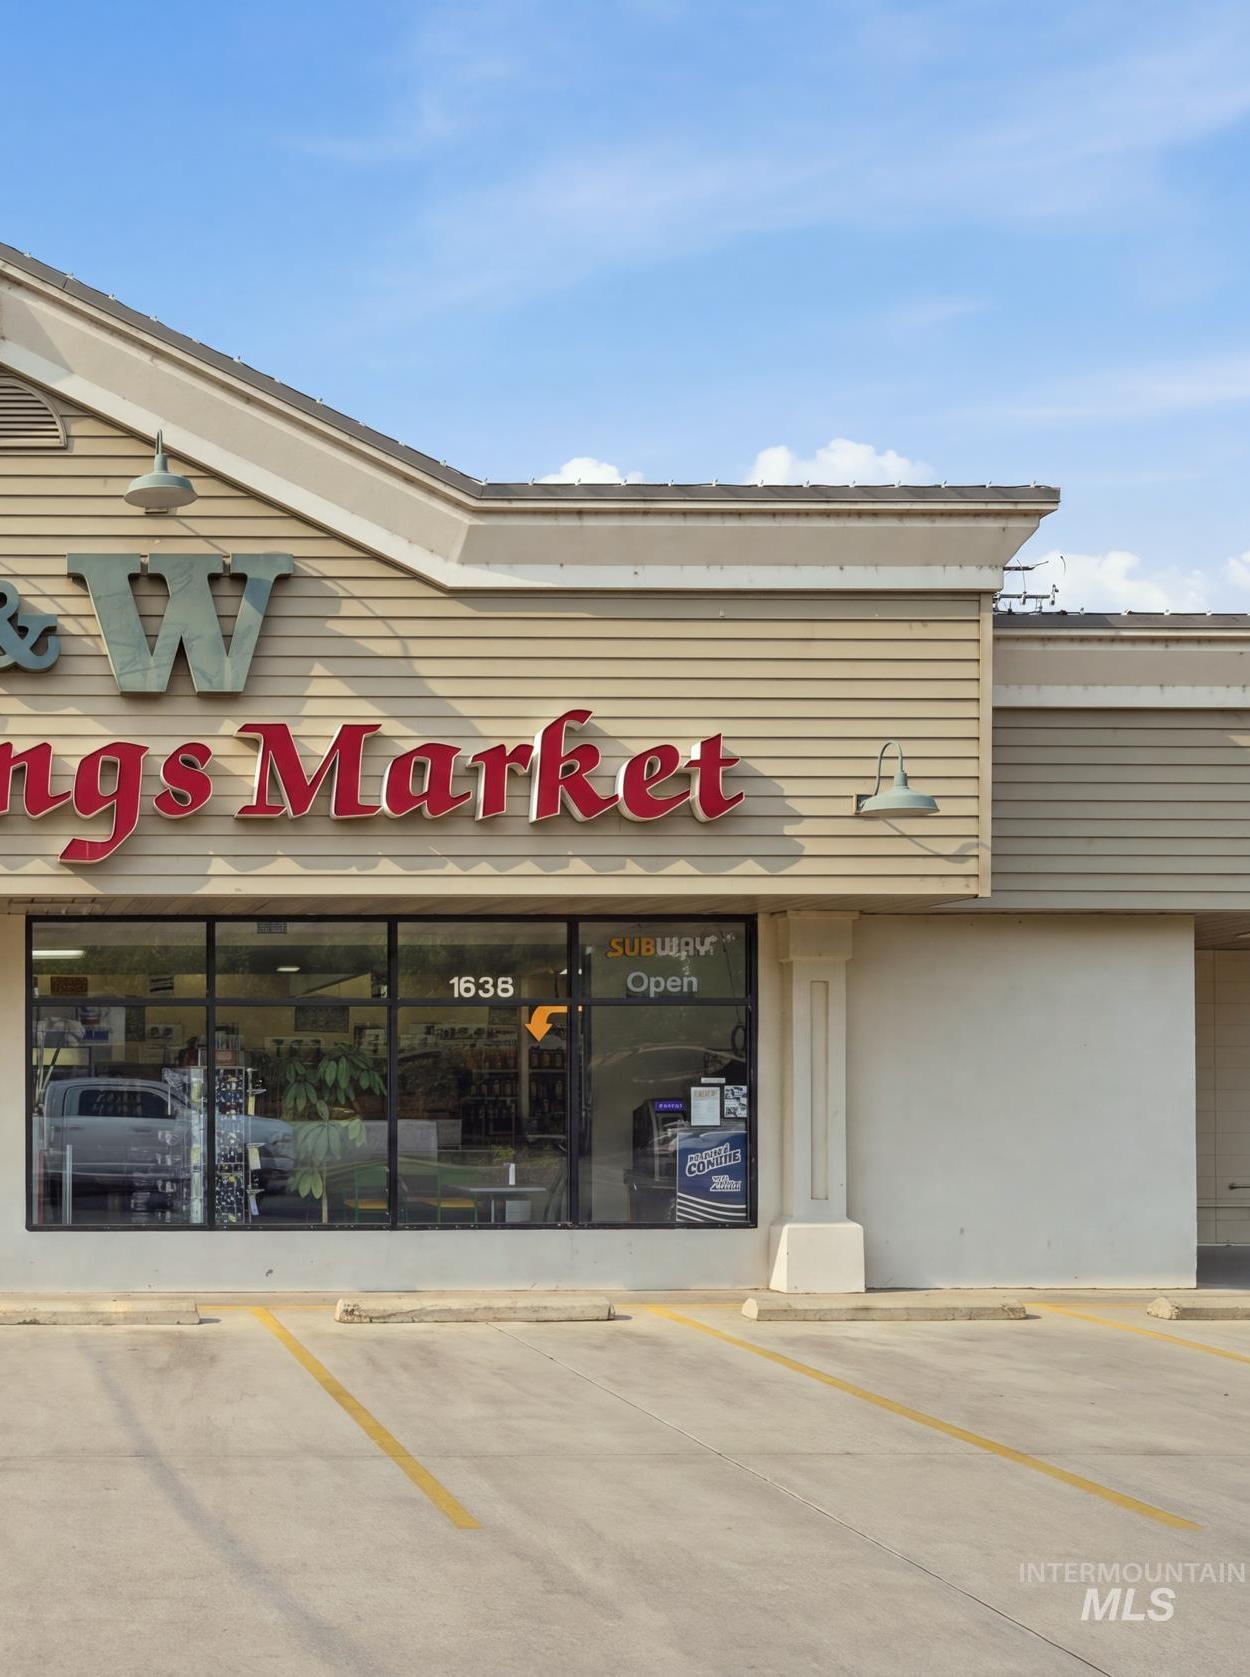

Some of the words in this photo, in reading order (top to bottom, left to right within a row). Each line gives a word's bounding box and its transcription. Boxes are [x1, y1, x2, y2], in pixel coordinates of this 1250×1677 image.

[66, 553, 294, 696] W
[233, 708, 746, 825] Market
[606, 936, 717, 959] SUBWAY
[626, 971, 698, 998] Open
